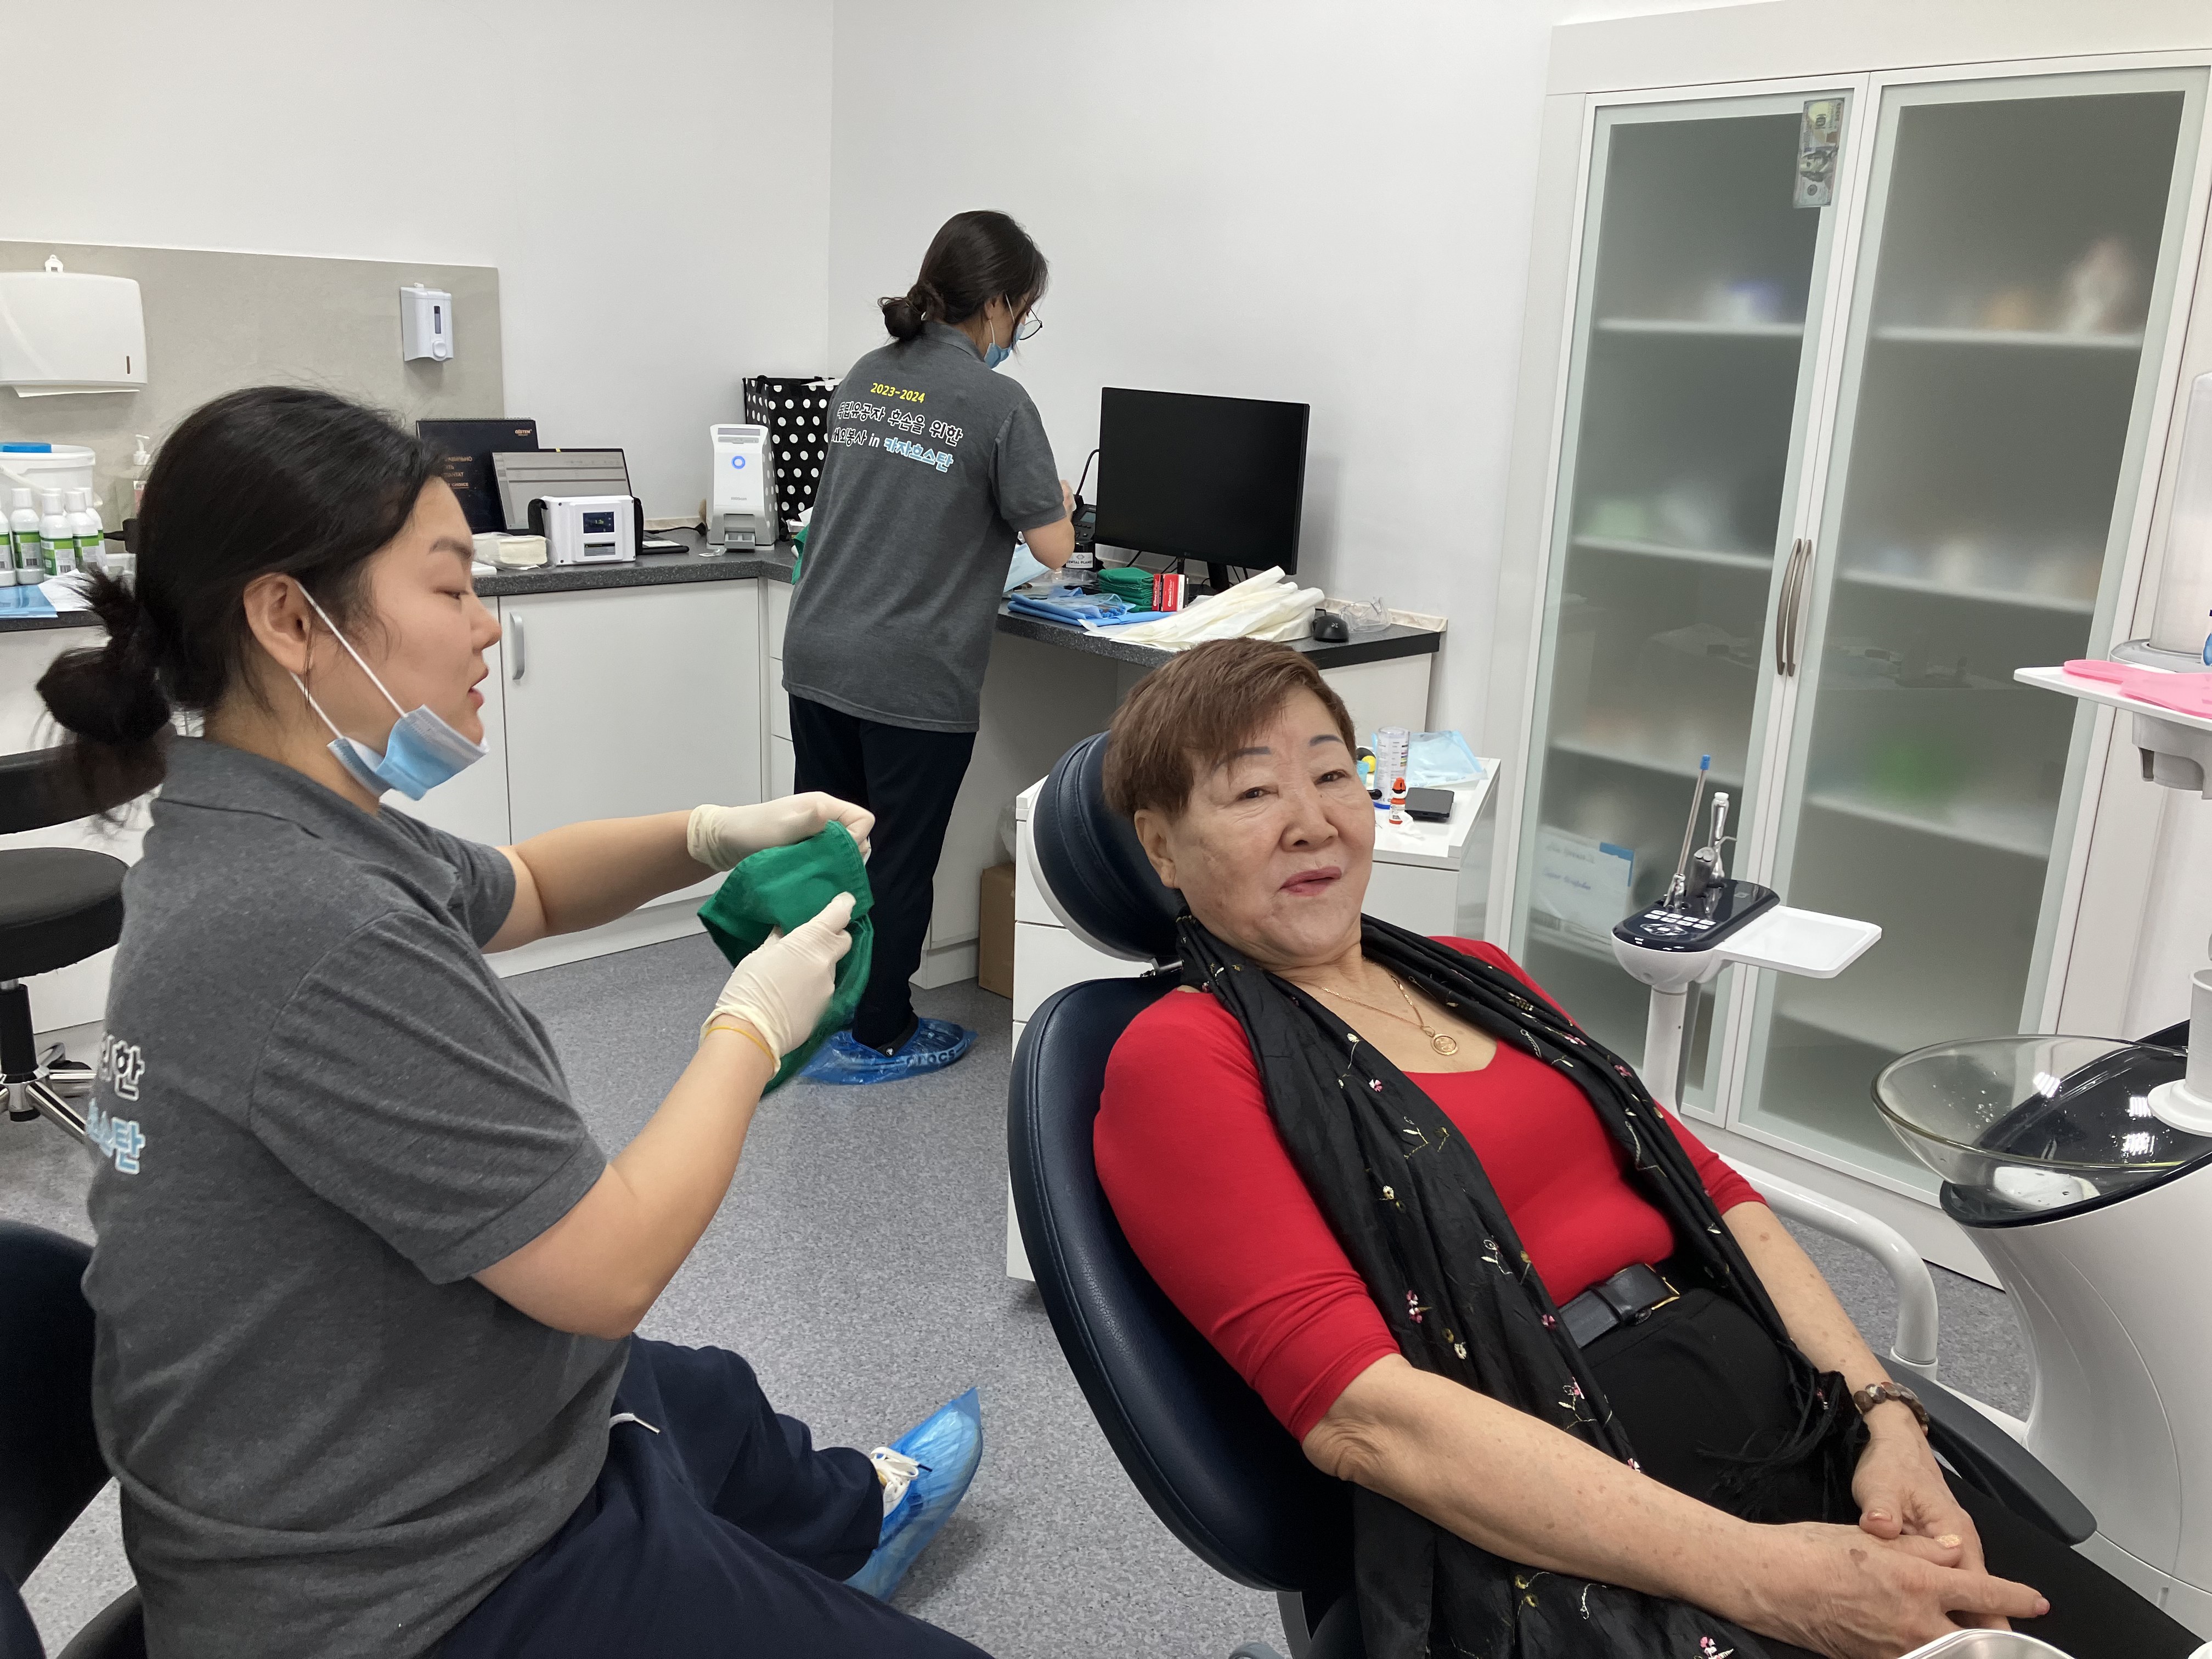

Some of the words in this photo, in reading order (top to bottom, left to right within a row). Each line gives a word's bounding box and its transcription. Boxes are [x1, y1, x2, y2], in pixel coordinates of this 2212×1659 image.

[870, 382, 926, 403] 2023-2024
[888, 409, 926, 435] 후손을
[929, 419, 963, 447] 위한
[868, 433, 880, 448] in
[883, 437, 954, 473] 카자흐스탄
